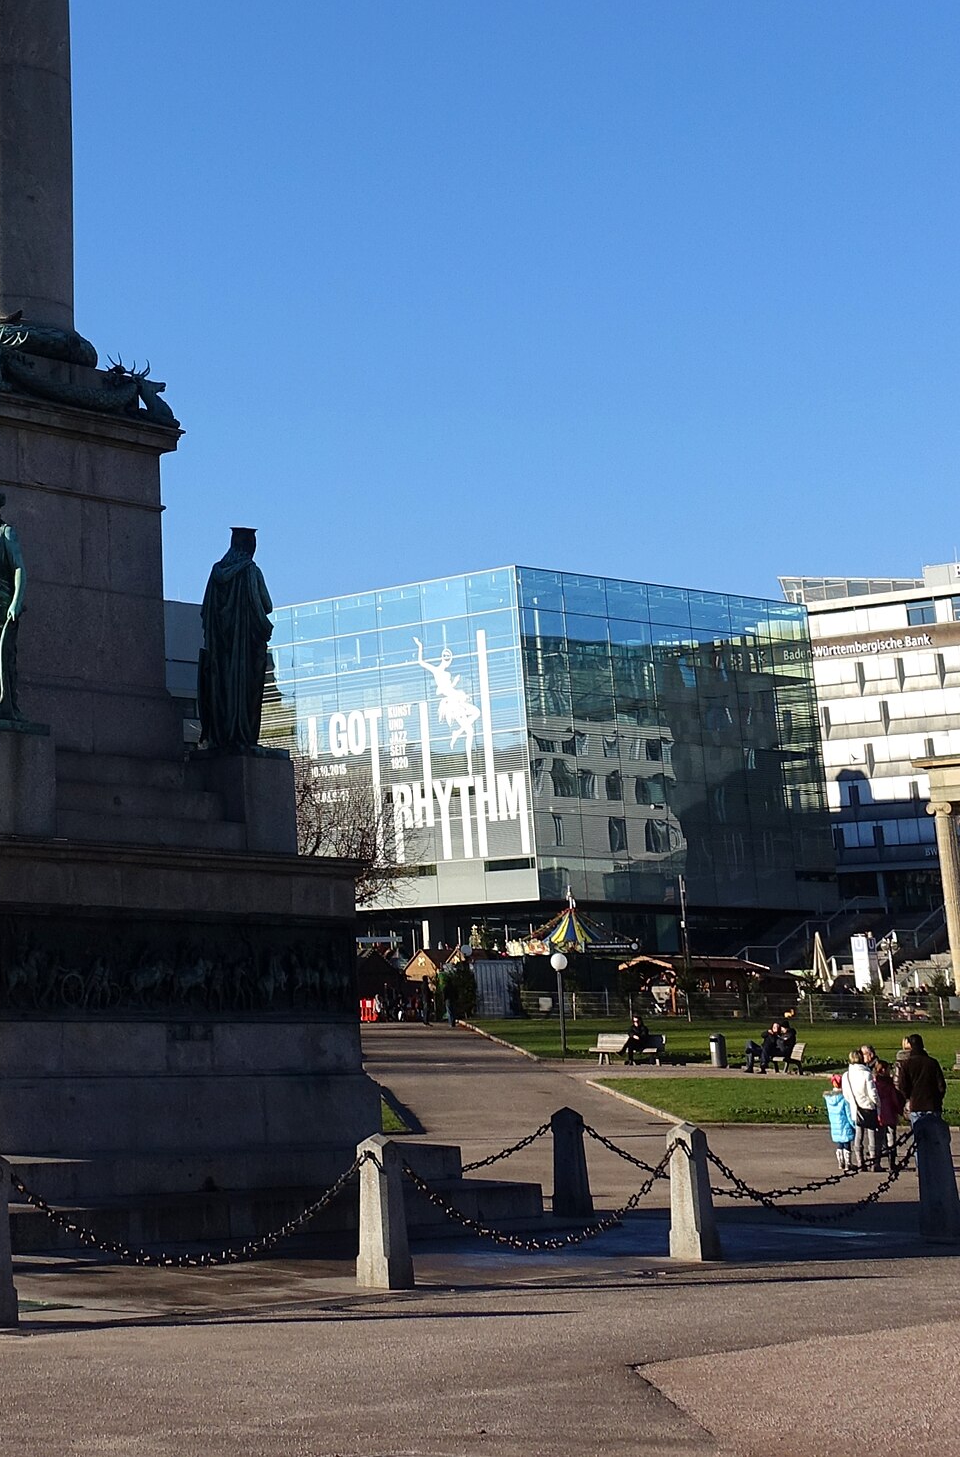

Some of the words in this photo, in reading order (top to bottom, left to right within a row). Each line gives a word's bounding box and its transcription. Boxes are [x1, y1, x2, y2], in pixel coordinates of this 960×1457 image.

[905, 633, 931, 647] Bank
[387, 704, 412, 717] KUNST
[388, 717, 404, 731] UND
[389, 730, 408, 744] JAZZ
[389, 743, 407, 757] SEIT
